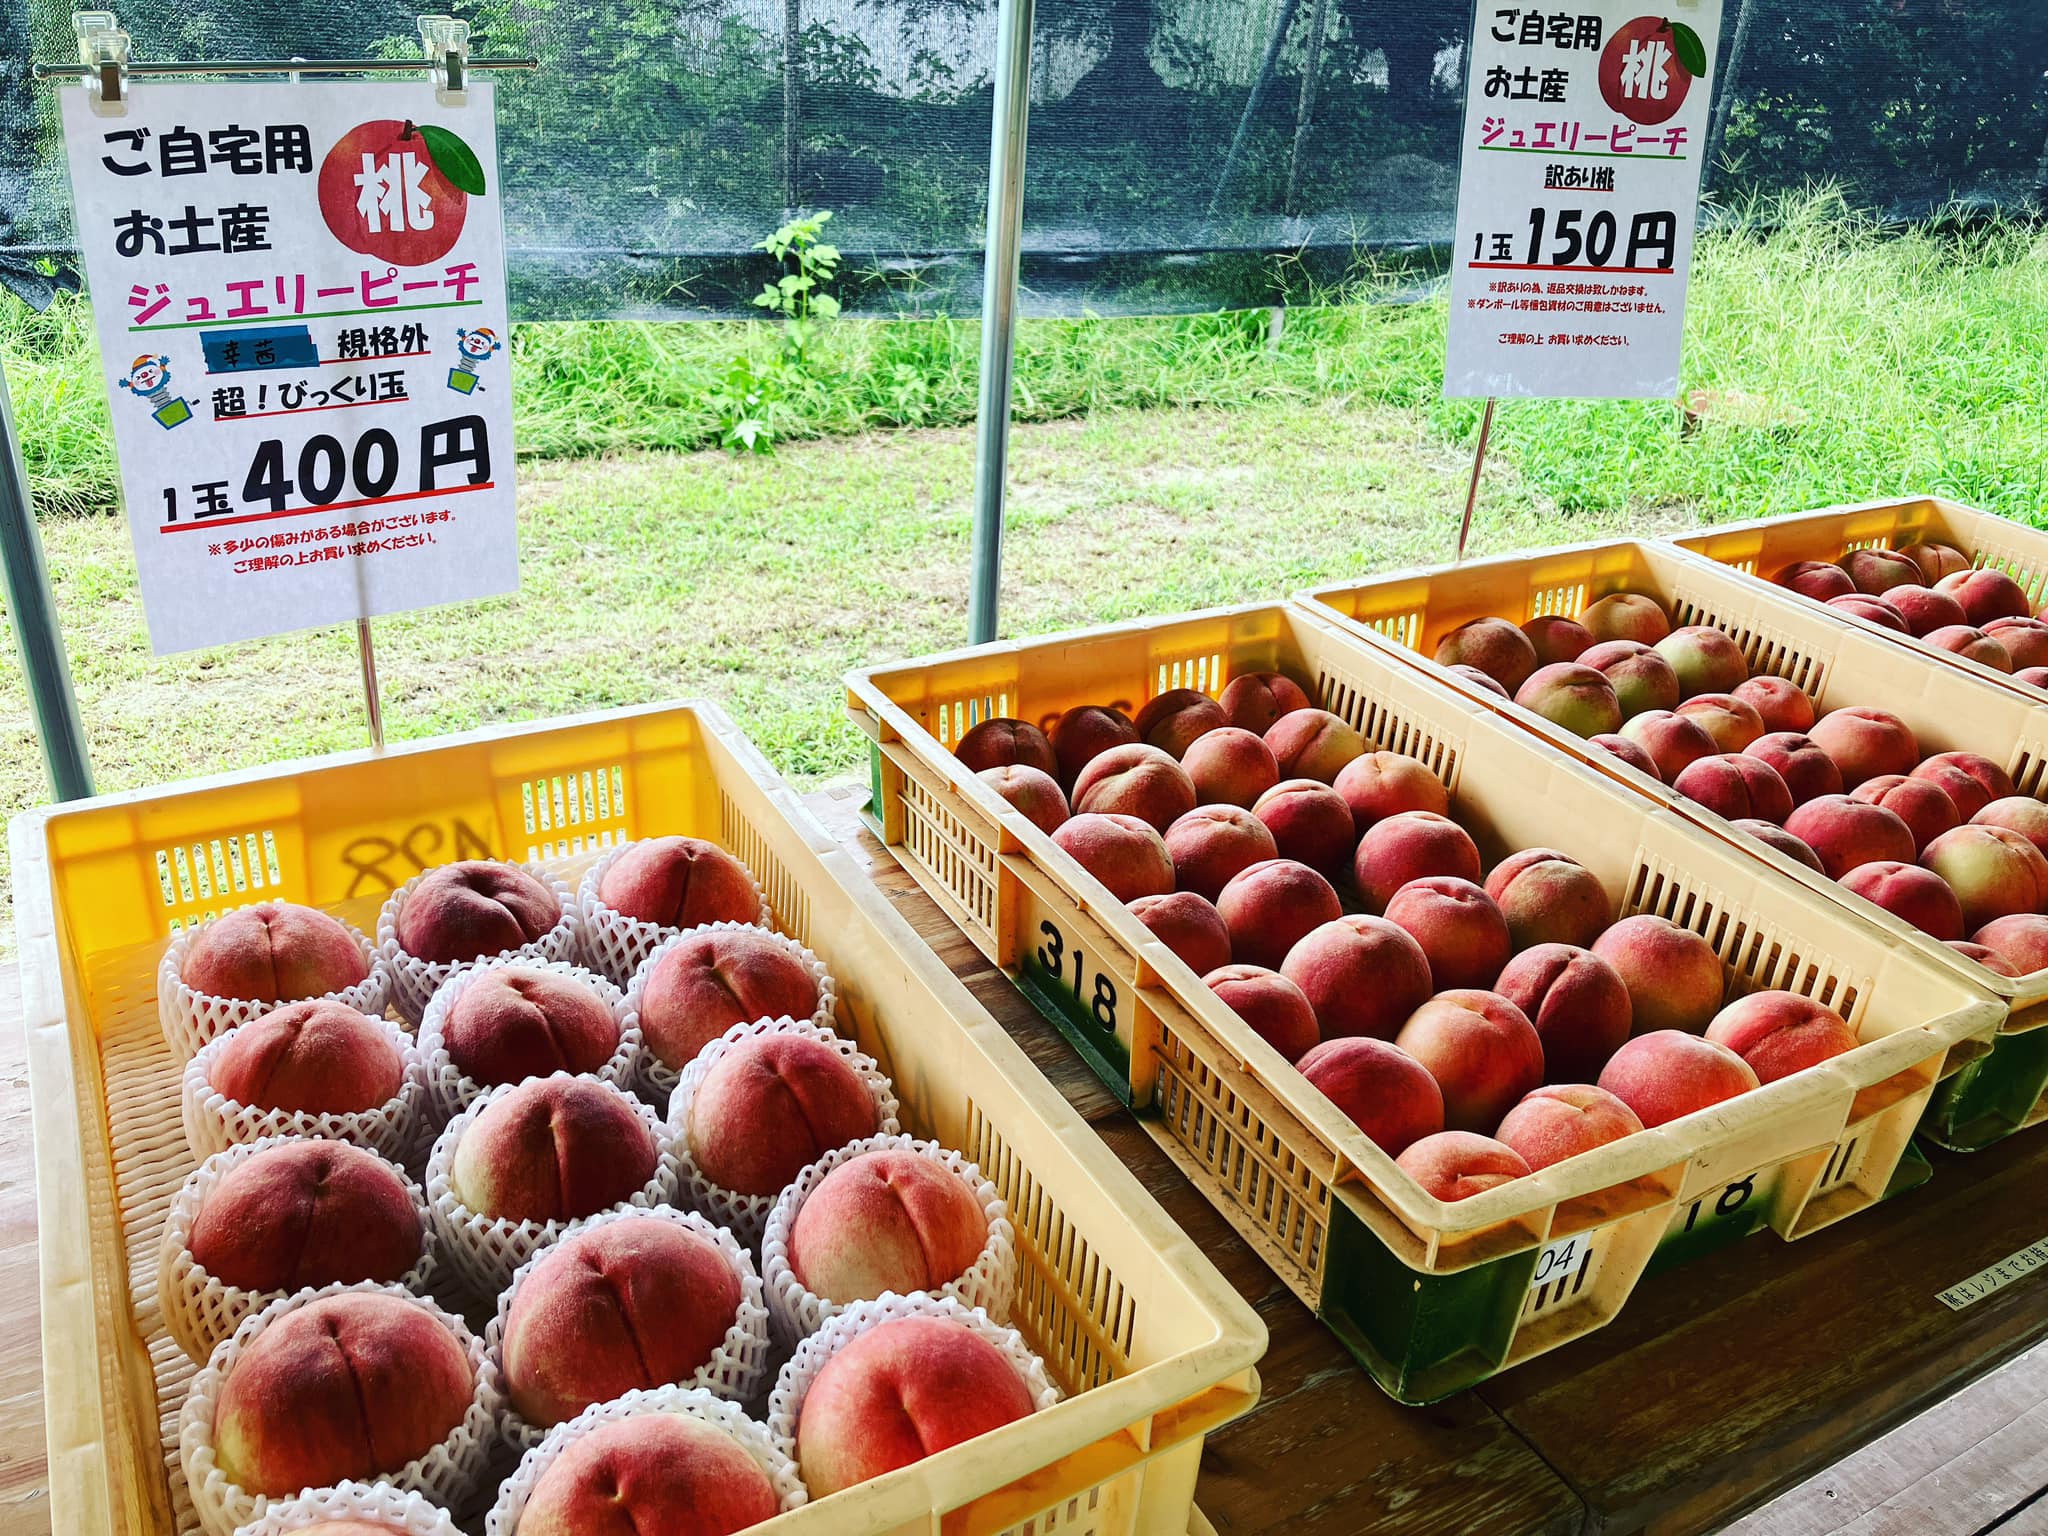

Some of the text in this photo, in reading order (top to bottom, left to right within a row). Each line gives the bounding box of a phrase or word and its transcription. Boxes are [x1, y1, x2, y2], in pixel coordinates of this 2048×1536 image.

[1491, 9, 1603, 51] ご自宅用
[1484, 65, 1569, 102] お土産
[1619, 39, 1673, 100] 桃
[101, 123, 314, 177] ご自宅用
[1481, 116, 1688, 156] ジュエリーピーチ
[353, 151, 435, 233] 桃
[1545, 164, 1616, 189] 訳あり桃
[113, 203, 272, 258] お土産
[128, 262, 480, 326] ジュエリーピーチ
[337, 323, 430, 360] 規格外
[232, 531, 438, 574] ご理解の上お買い求めください。
[1037, 919, 1117, 1034] 318
